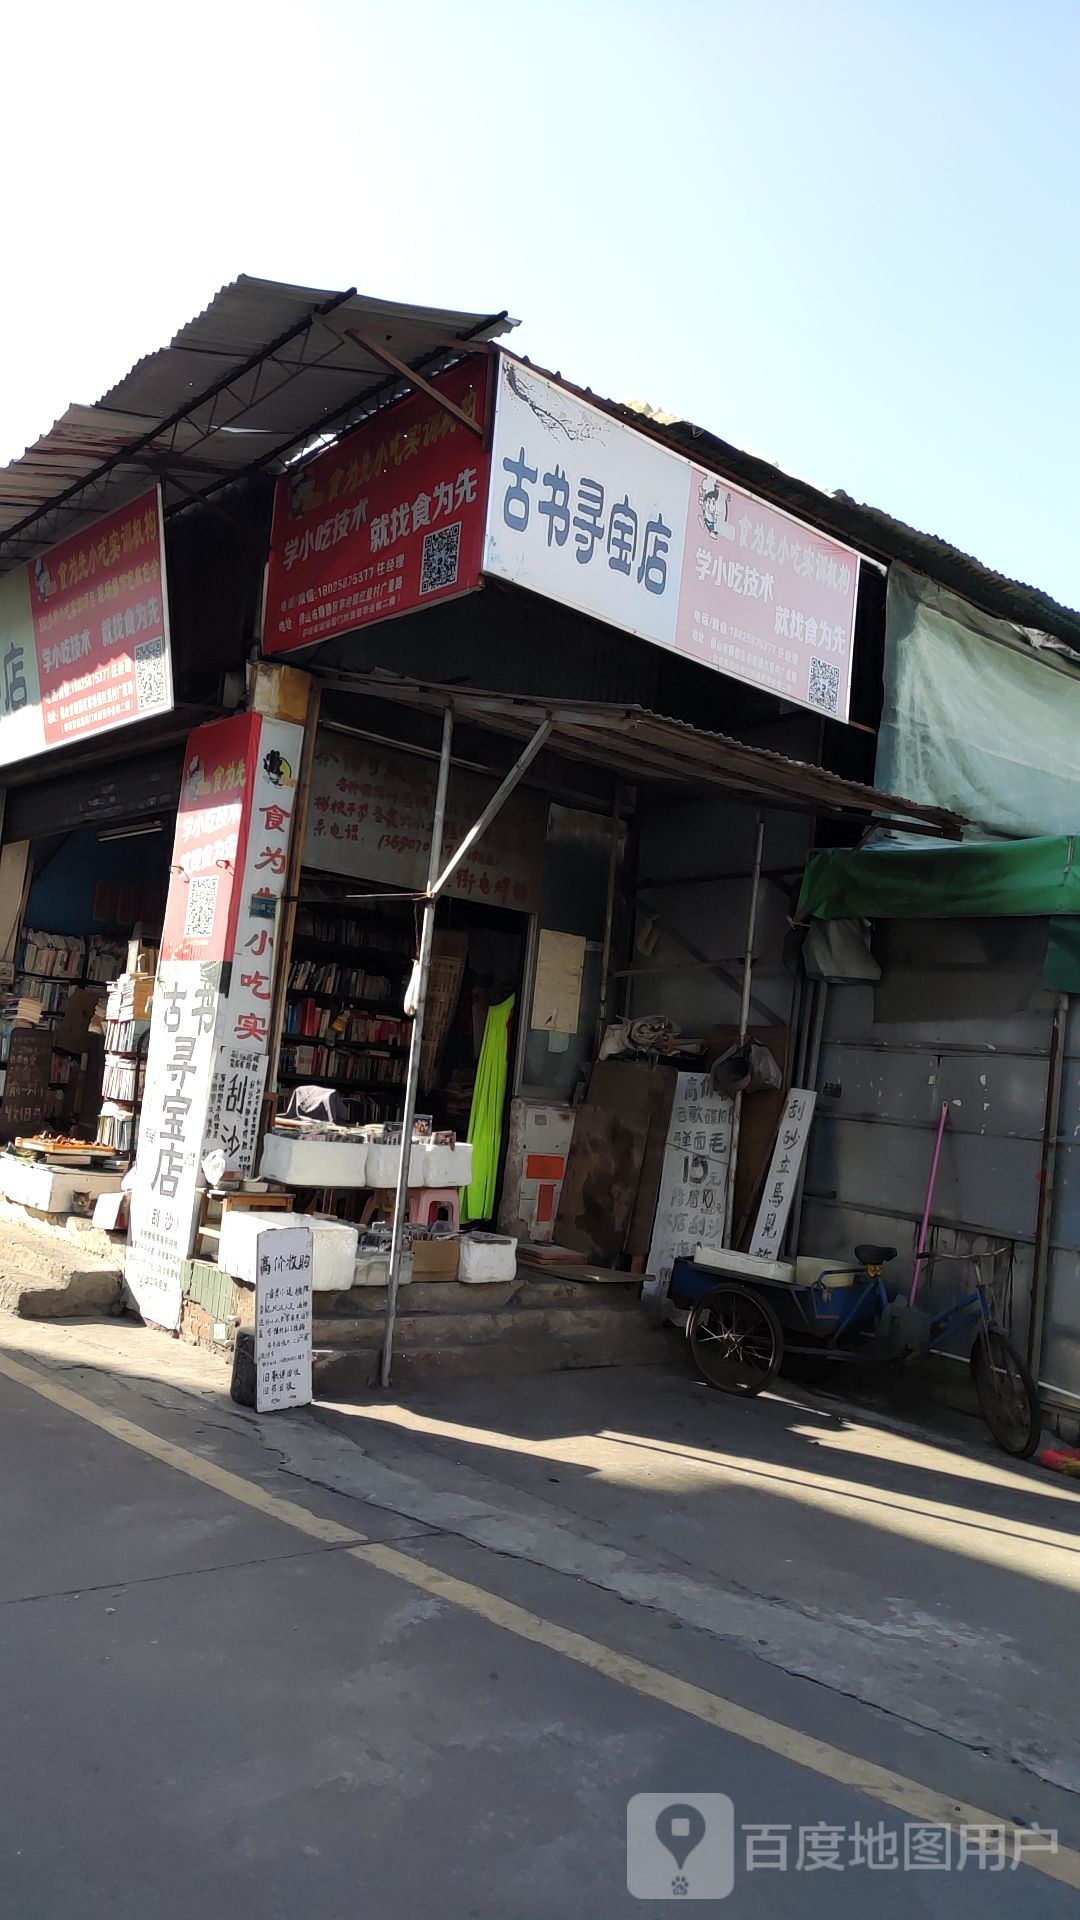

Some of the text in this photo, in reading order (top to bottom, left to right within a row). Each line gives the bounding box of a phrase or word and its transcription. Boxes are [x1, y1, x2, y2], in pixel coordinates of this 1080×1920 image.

[283, 467, 477, 571] 学小吃技术 就找食为先
[503, 447, 672, 595] 古书寻宝店
[41, 596, 160, 673] 学小吃技术 就找食为先
[695, 548, 846, 656] 学小吃技术 就找食为先
[4, 642, 27, 713] 店
[221, 1073, 249, 1157] 刮沙
[260, 1254, 310, 1275] 高价收购
